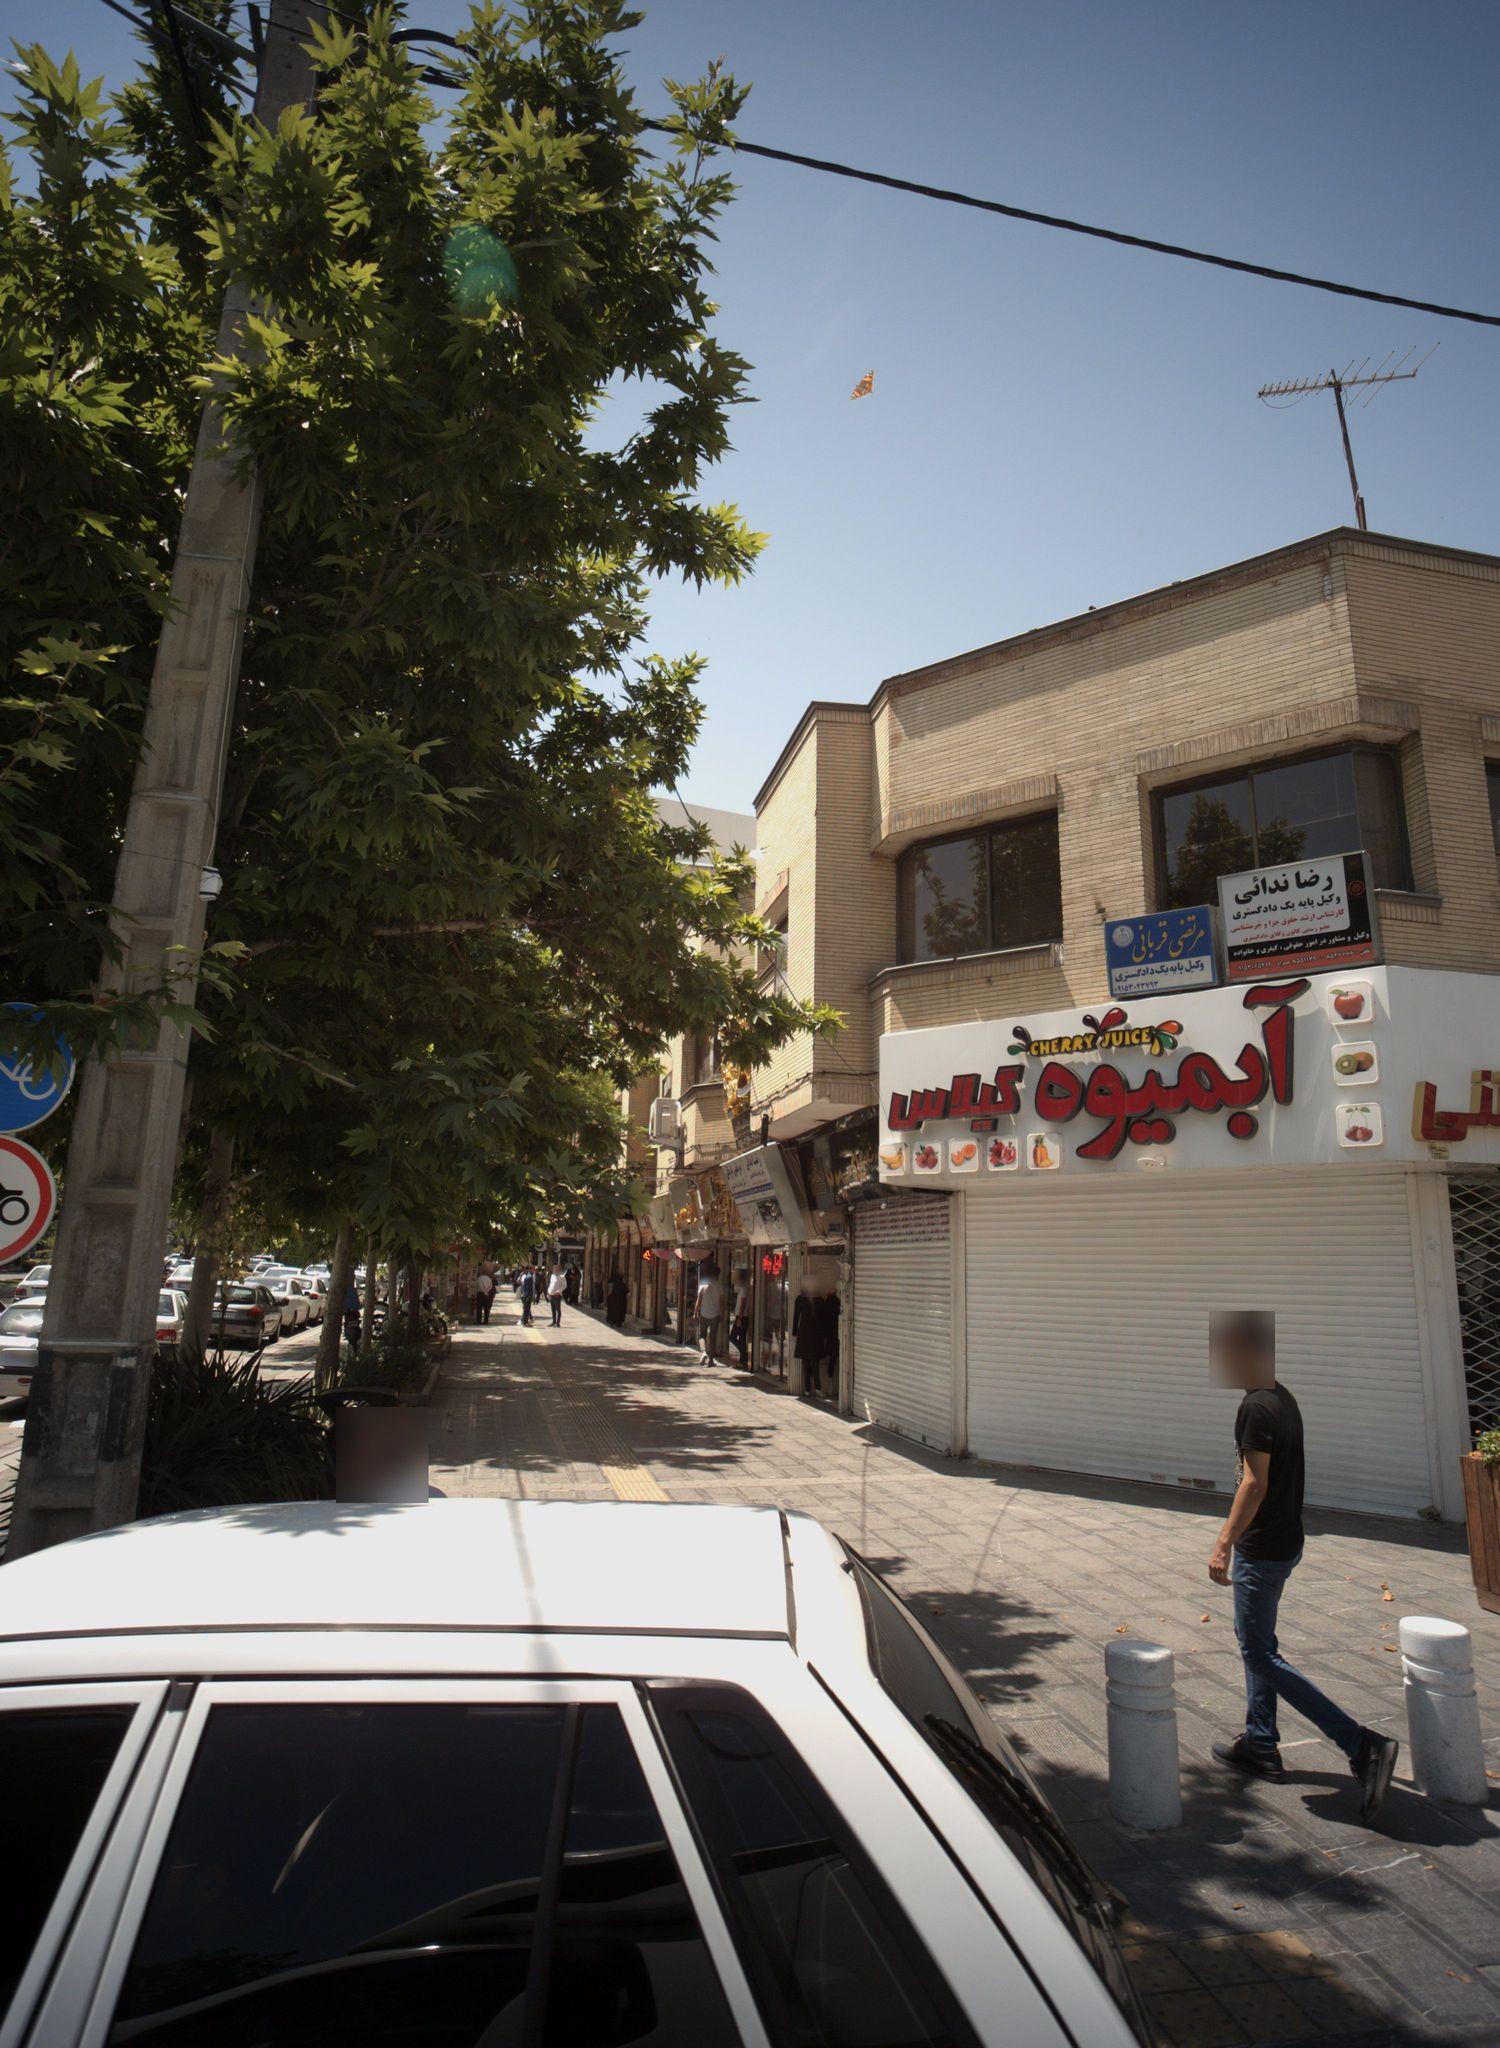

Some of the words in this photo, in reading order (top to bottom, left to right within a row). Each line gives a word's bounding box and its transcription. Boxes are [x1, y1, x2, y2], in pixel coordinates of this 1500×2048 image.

[1295, 868, 1334, 891] رضا
[1280, 900, 1295, 911] یک
[1298, 897, 1314, 909] پایه
[1317, 893, 1341, 906] وکیل
[1155, 964, 1169, 976] یک
[1169, 962, 1184, 975] پایه
[1185, 959, 1205, 973] وکیل
[1028, 1033, 1098, 1057] CHERRY
[1100, 1026, 1153, 1049] JUICE
[1035, 979, 1312, 1161] آبمیوه
